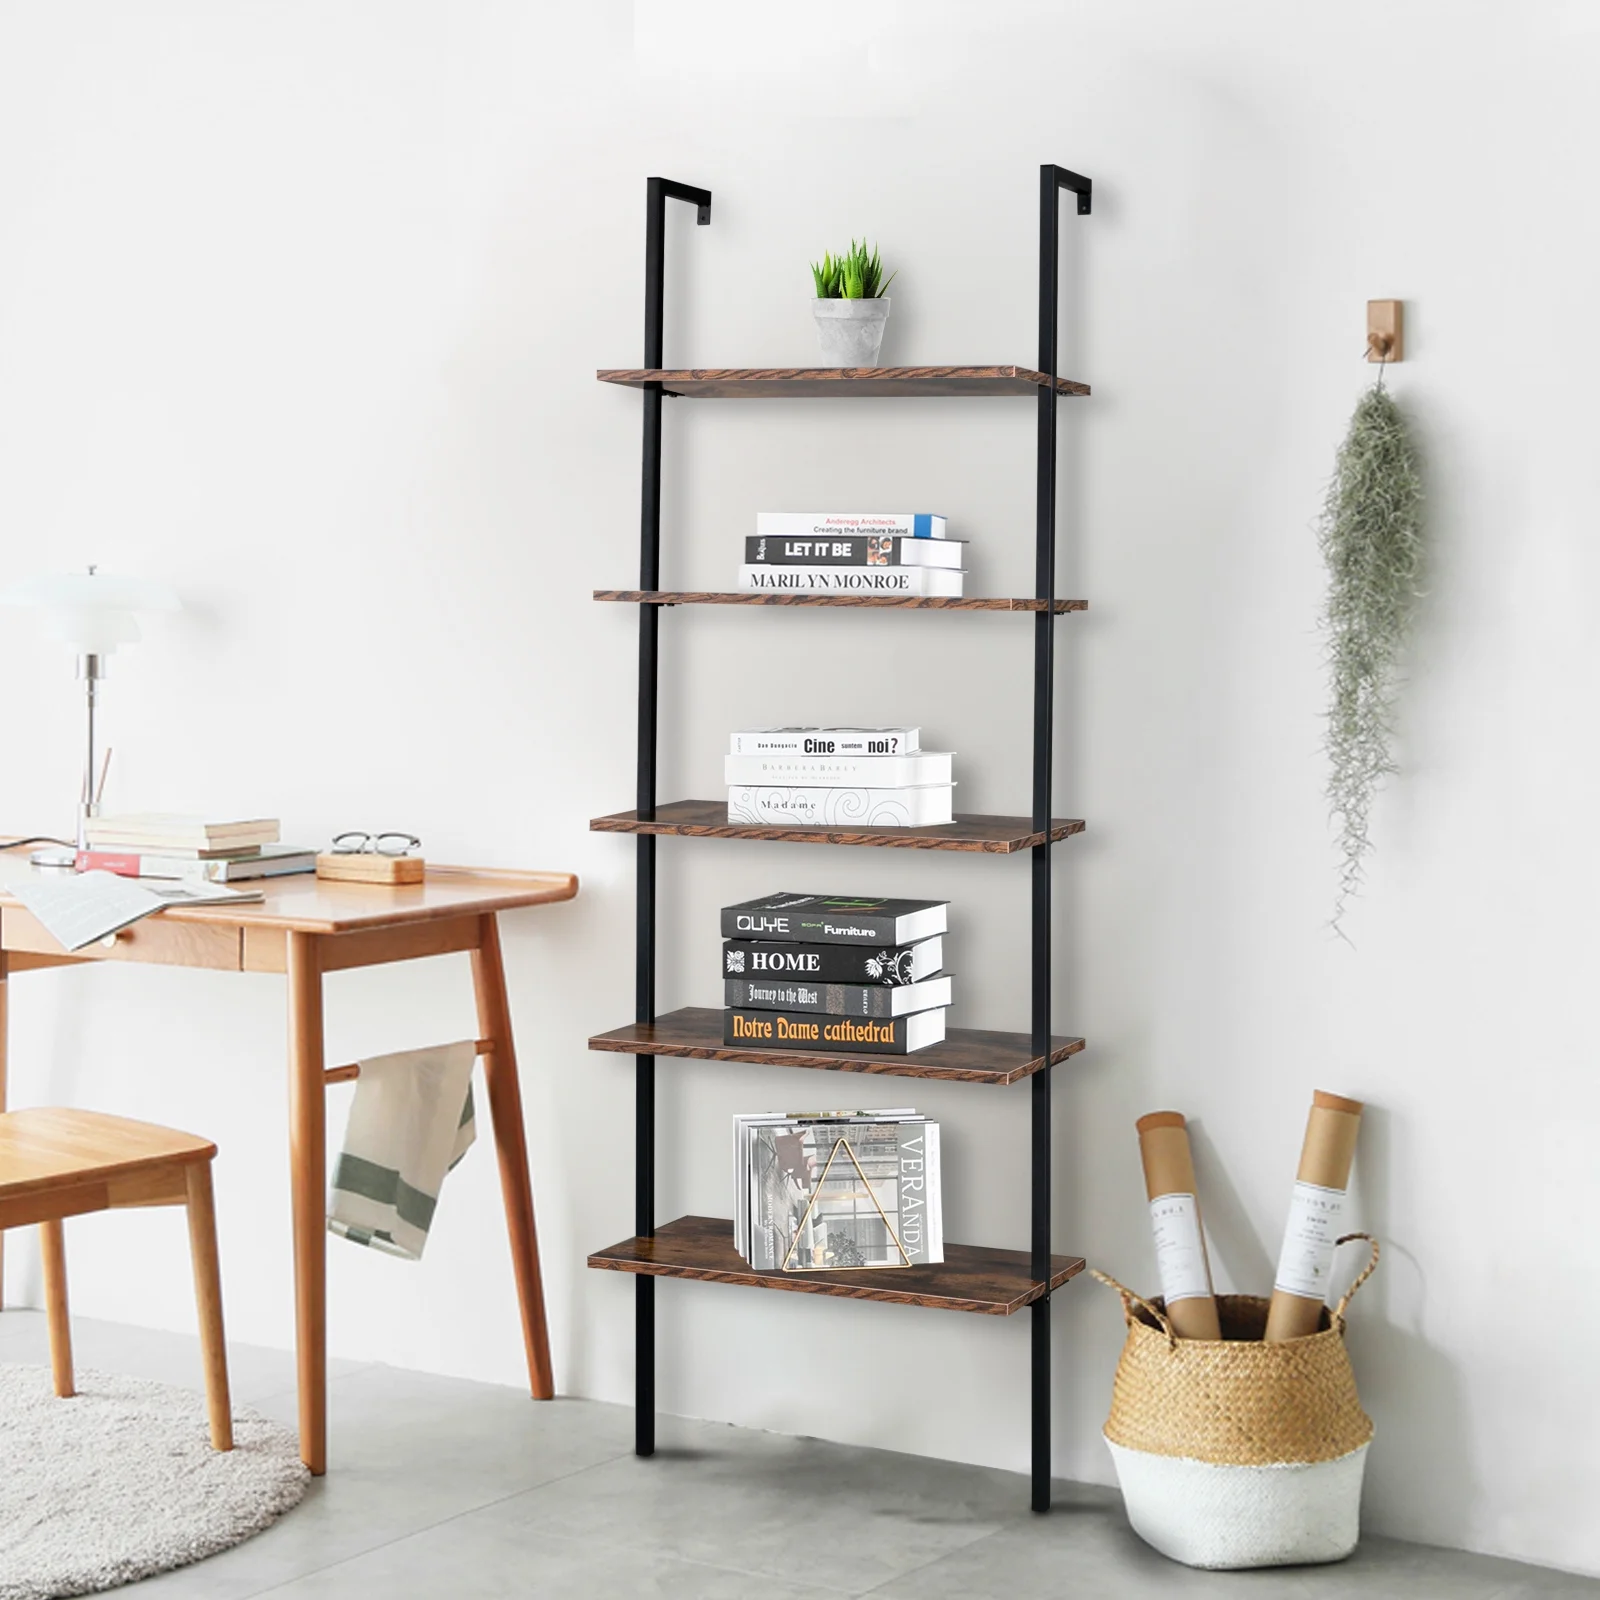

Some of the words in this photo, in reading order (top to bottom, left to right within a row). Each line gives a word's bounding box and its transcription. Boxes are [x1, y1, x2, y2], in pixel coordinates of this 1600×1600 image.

[825, 518, 859, 526] Anderegg
[813, 526, 842, 535] Creating
[844, 526, 855, 534] the
[856, 526, 887, 534] furniture
[785, 542, 812, 556] LET
[815, 542, 829, 557] IT
[832, 543, 852, 557] BE
[750, 573, 830, 588] MARILYN
[833, 574, 909, 589] MONROE
[804, 738, 835, 754] Cine
[868, 737, 898, 754] noi?
[760, 800, 816, 809] Madame
[824, 923, 876, 938] Furniture
[752, 952, 821, 971] HOME
[748, 983, 777, 1005] Journey
[777, 988, 785, 1001] to
[786, 987, 797, 1005] the
[797, 987, 818, 1004] West
[733, 1015, 772, 1039] Notre
[776, 1016, 819, 1040] Dame
[823, 1019, 895, 1043] cathedral
[900, 1135, 925, 1258] VERANDA
